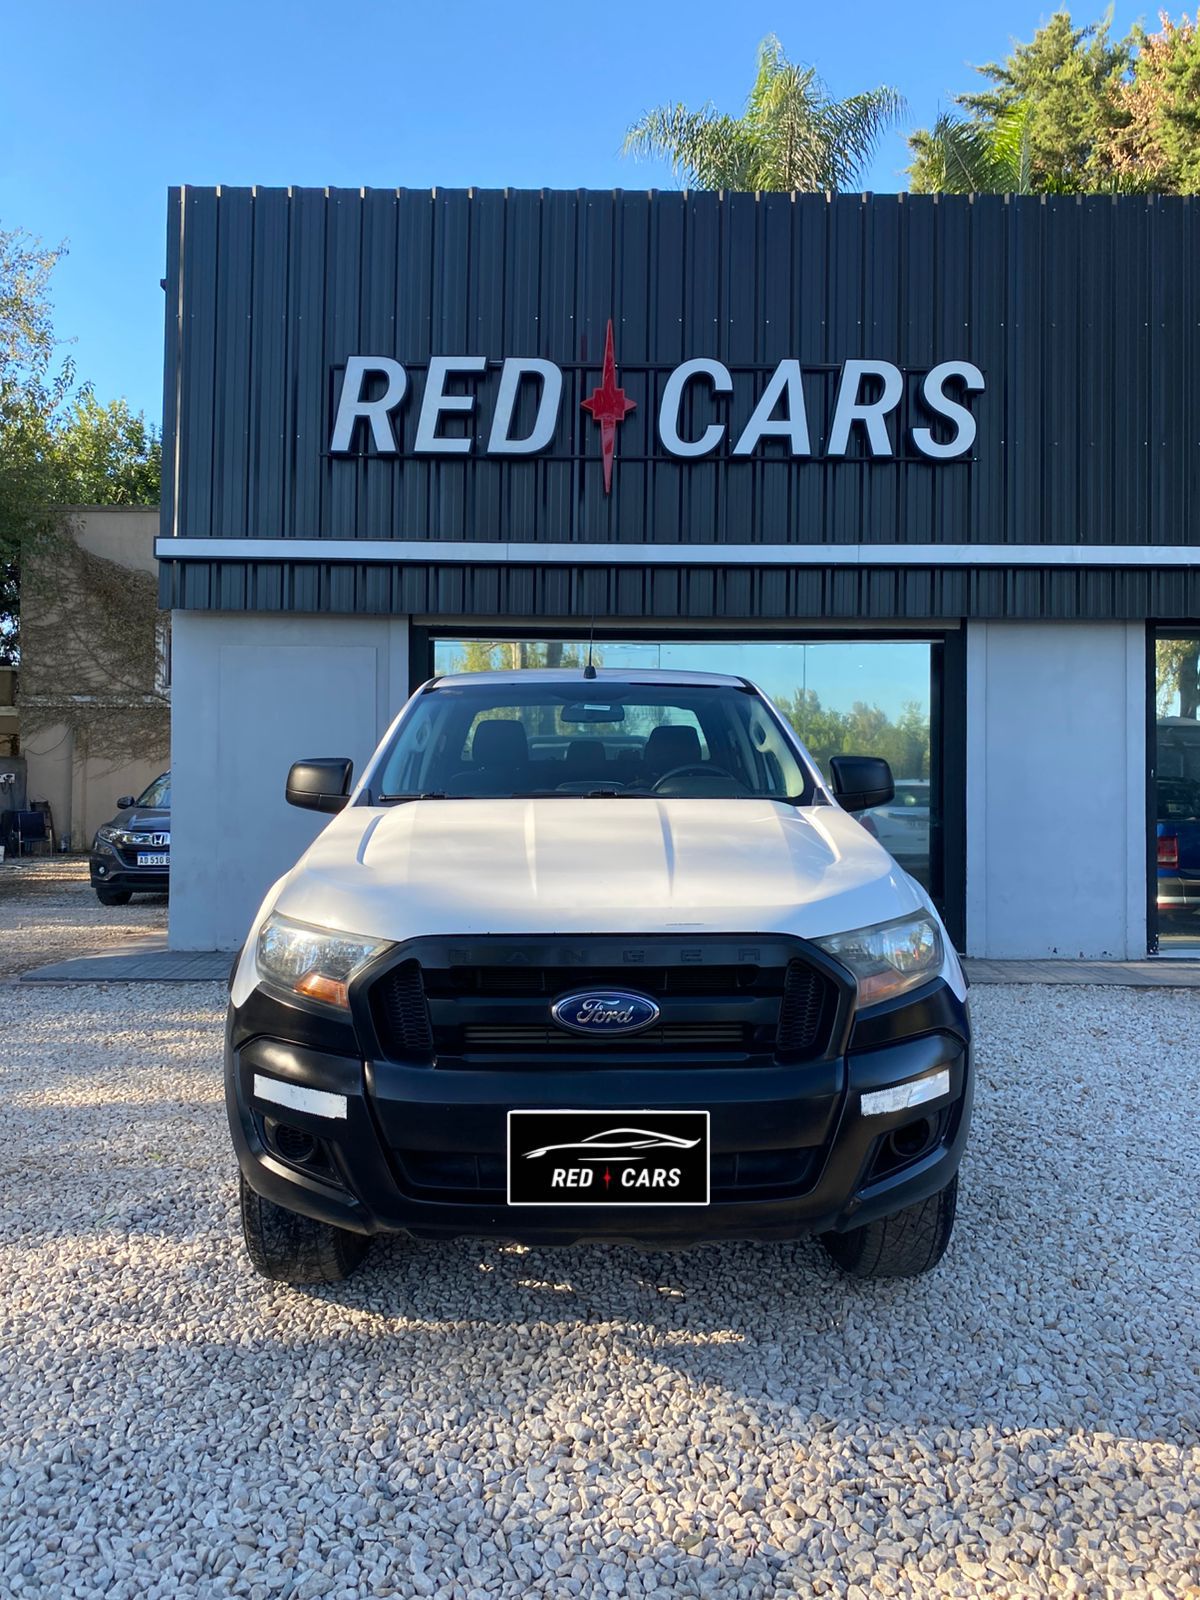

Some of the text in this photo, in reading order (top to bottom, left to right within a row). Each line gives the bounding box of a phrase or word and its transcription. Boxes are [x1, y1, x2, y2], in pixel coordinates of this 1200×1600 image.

[329, 355, 986, 460] RED CARS
[150, 856, 164, 864] 510
[448, 948, 761, 963] RANGER
[576, 999, 634, 1025] Ford
